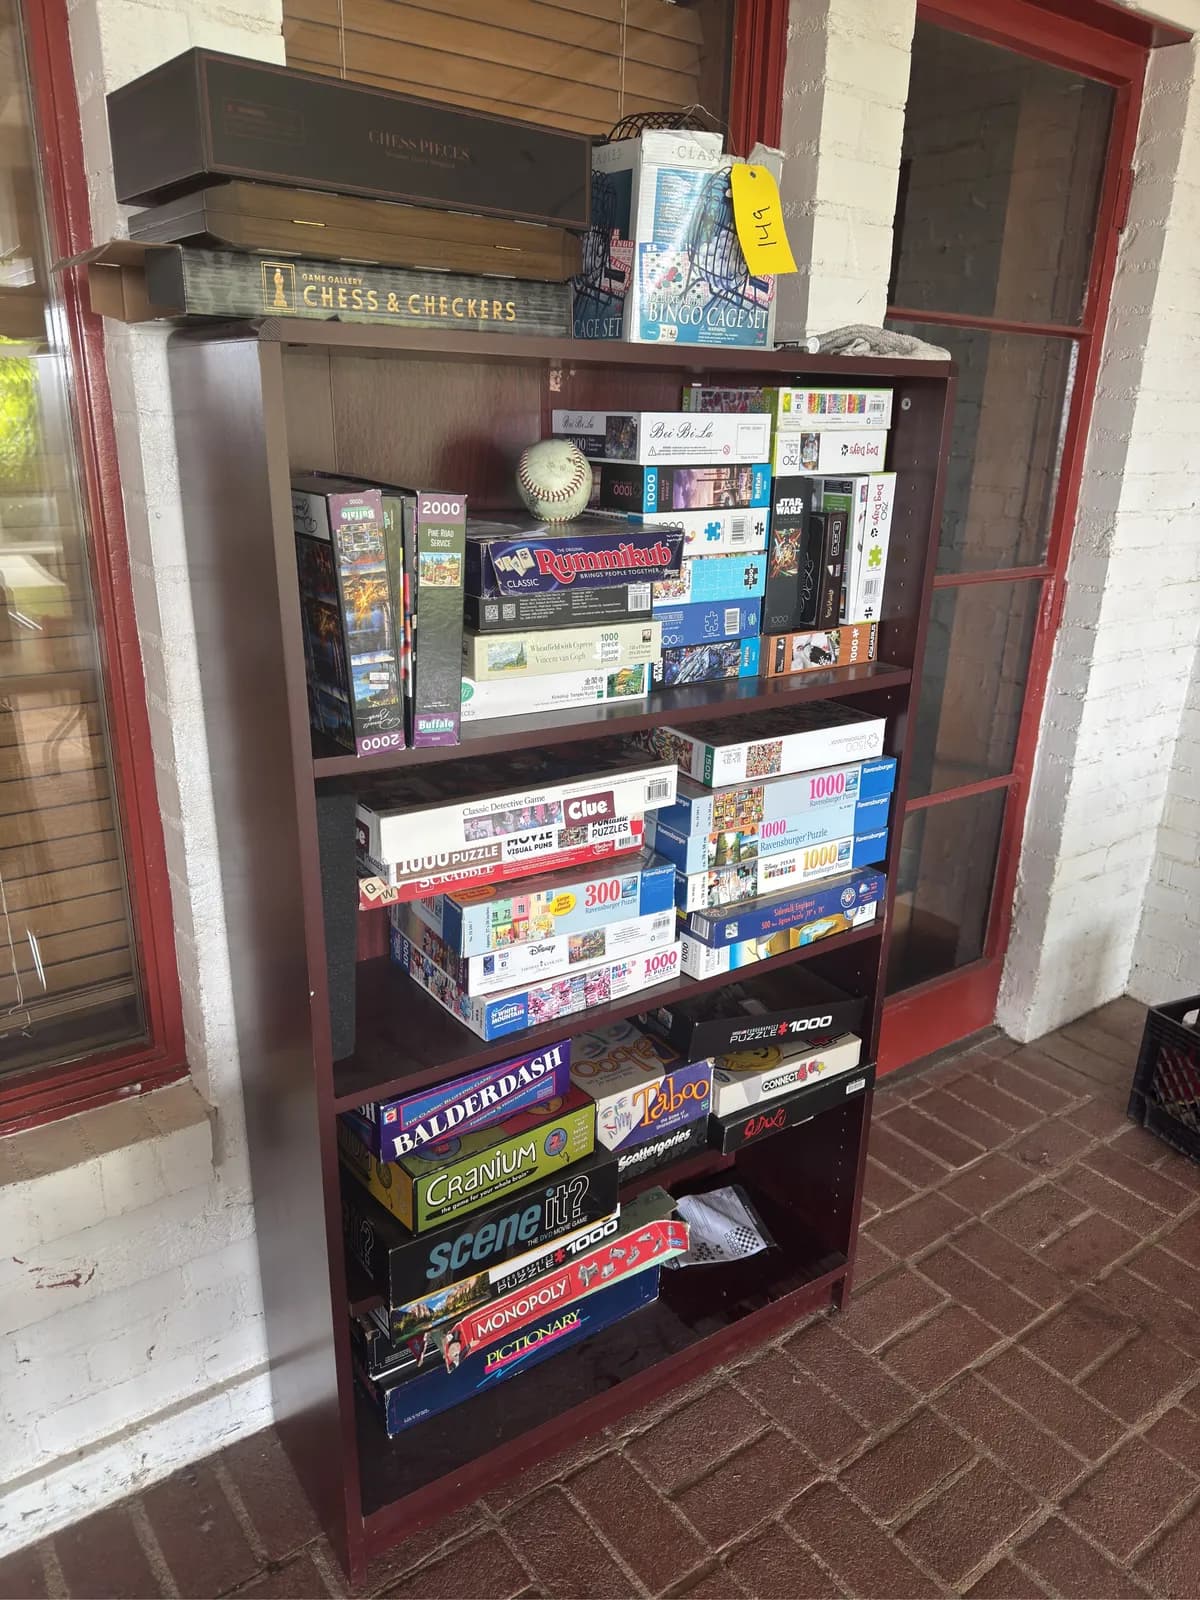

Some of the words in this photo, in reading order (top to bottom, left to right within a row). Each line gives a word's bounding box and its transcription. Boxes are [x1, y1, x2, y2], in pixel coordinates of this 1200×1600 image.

[367, 130, 418, 149] CHESS
[420, 137, 471, 161] PIECES
[752, 205, 778, 248] 149
[610, 240, 635, 248] INGO
[302, 273, 326, 284] GAME
[327, 275, 363, 286] GALLERY
[303, 285, 379, 312] CHESS
[386, 292, 400, 314] &
[407, 293, 518, 322] CHECKERS
[648, 302, 703, 326] BINGO
[706, 306, 746, 328] CAGE
[747, 309, 769, 329] SET
[574, 318, 601, 338] CAGE
[601, 317, 622, 337] SET
[649, 421, 675, 439] Bei
[675, 422, 697, 439] Bi
[695, 421, 714, 439] La
[849, 441, 866, 456] Days
[866, 441, 879, 456] Dog
[782, 454, 800, 466] 750
[613, 483, 633, 496] 1000
[646, 473, 656, 508] 1000
[874, 483, 885, 502] Dog
[421, 500, 461, 515] 2000
[775, 505, 803, 515] WARS
[778, 497, 804, 507] STAR
[340, 507, 376, 520] Buffalo
[440, 528, 455, 538] ROAD
[430, 537, 452, 548] SERVICE
[533, 540, 673, 585] Rummikub
[506, 577, 541, 589] CLASSIC
[579, 570, 604, 580] BRINGS
[604, 568, 628, 577] PEOPLE
[600, 632, 619, 642] 1000
[601, 641, 620, 649] piece
[535, 654, 559, 664] Vincent
[558, 654, 570, 662] van
[600, 648, 619, 659] jigsaw
[849, 637, 860, 663] 1000
[600, 656, 619, 664] puzzle
[418, 718, 455, 731] Buffalo
[361, 733, 400, 752] 2000
[704, 750, 714, 780] 1500
[862, 762, 895, 775] Ravensburger
[809, 772, 846, 800] 1000
[462, 802, 490, 816] Classic
[490, 795, 525, 812] Detective
[524, 793, 546, 804] Game
[568, 799, 609, 820] Clue
[809, 793, 843, 808] Ravensburger
[856, 796, 890, 809] Ravensburger
[591, 822, 630, 838] PUZZLES
[760, 819, 787, 840] 1000
[856, 830, 888, 843] Ravensburger
[506, 844, 534, 856] VISUAL
[534, 841, 553, 851] PUNS
[760, 834, 807, 853] Ravensburger
[807, 827, 829, 842] Puzzle
[399, 851, 450, 876] 1000
[451, 845, 499, 864] PUZZLE
[802, 843, 837, 872] 1000
[584, 879, 621, 908] 300
[584, 902, 620, 915] Ravensburger
[760, 920, 772, 930] 500
[401, 940, 411, 967] 1000
[528, 942, 557, 957] Disney
[681, 942, 690, 963] 1000
[643, 950, 678, 975] 1000
[655, 962, 677, 976] PUZZLE
[490, 1008, 526, 1026] MOUNTAIN
[498, 1004, 520, 1018] WHITE
[729, 1029, 777, 1044] PUZZLE
[789, 1015, 834, 1033] 1000
[761, 1071, 799, 1092] CONNECT
[391, 1045, 564, 1158] BALDERDASH
[632, 1076, 711, 1128] Taboo
[617, 1126, 692, 1173] Scattergories
[440, 1205, 452, 1215] the
[451, 1198, 469, 1211] game
[469, 1193, 479, 1202] for
[479, 1188, 494, 1200] your
[494, 1179, 512, 1192] whole
[511, 1170, 528, 1183] brain
[425, 1203, 543, 1279] scene
[544, 1174, 590, 1231] it?
[527, 1237, 540, 1248] THE
[539, 1231, 553, 1242] DVD
[552, 1223, 572, 1236] MOVIE
[571, 1215, 589, 1227] GAME
[497, 1258, 555, 1294] PUZZLE
[565, 1219, 619, 1255] 1000
[476, 1278, 567, 1339] MONOPOLY
[485, 1308, 581, 1368] PICTIONARY
